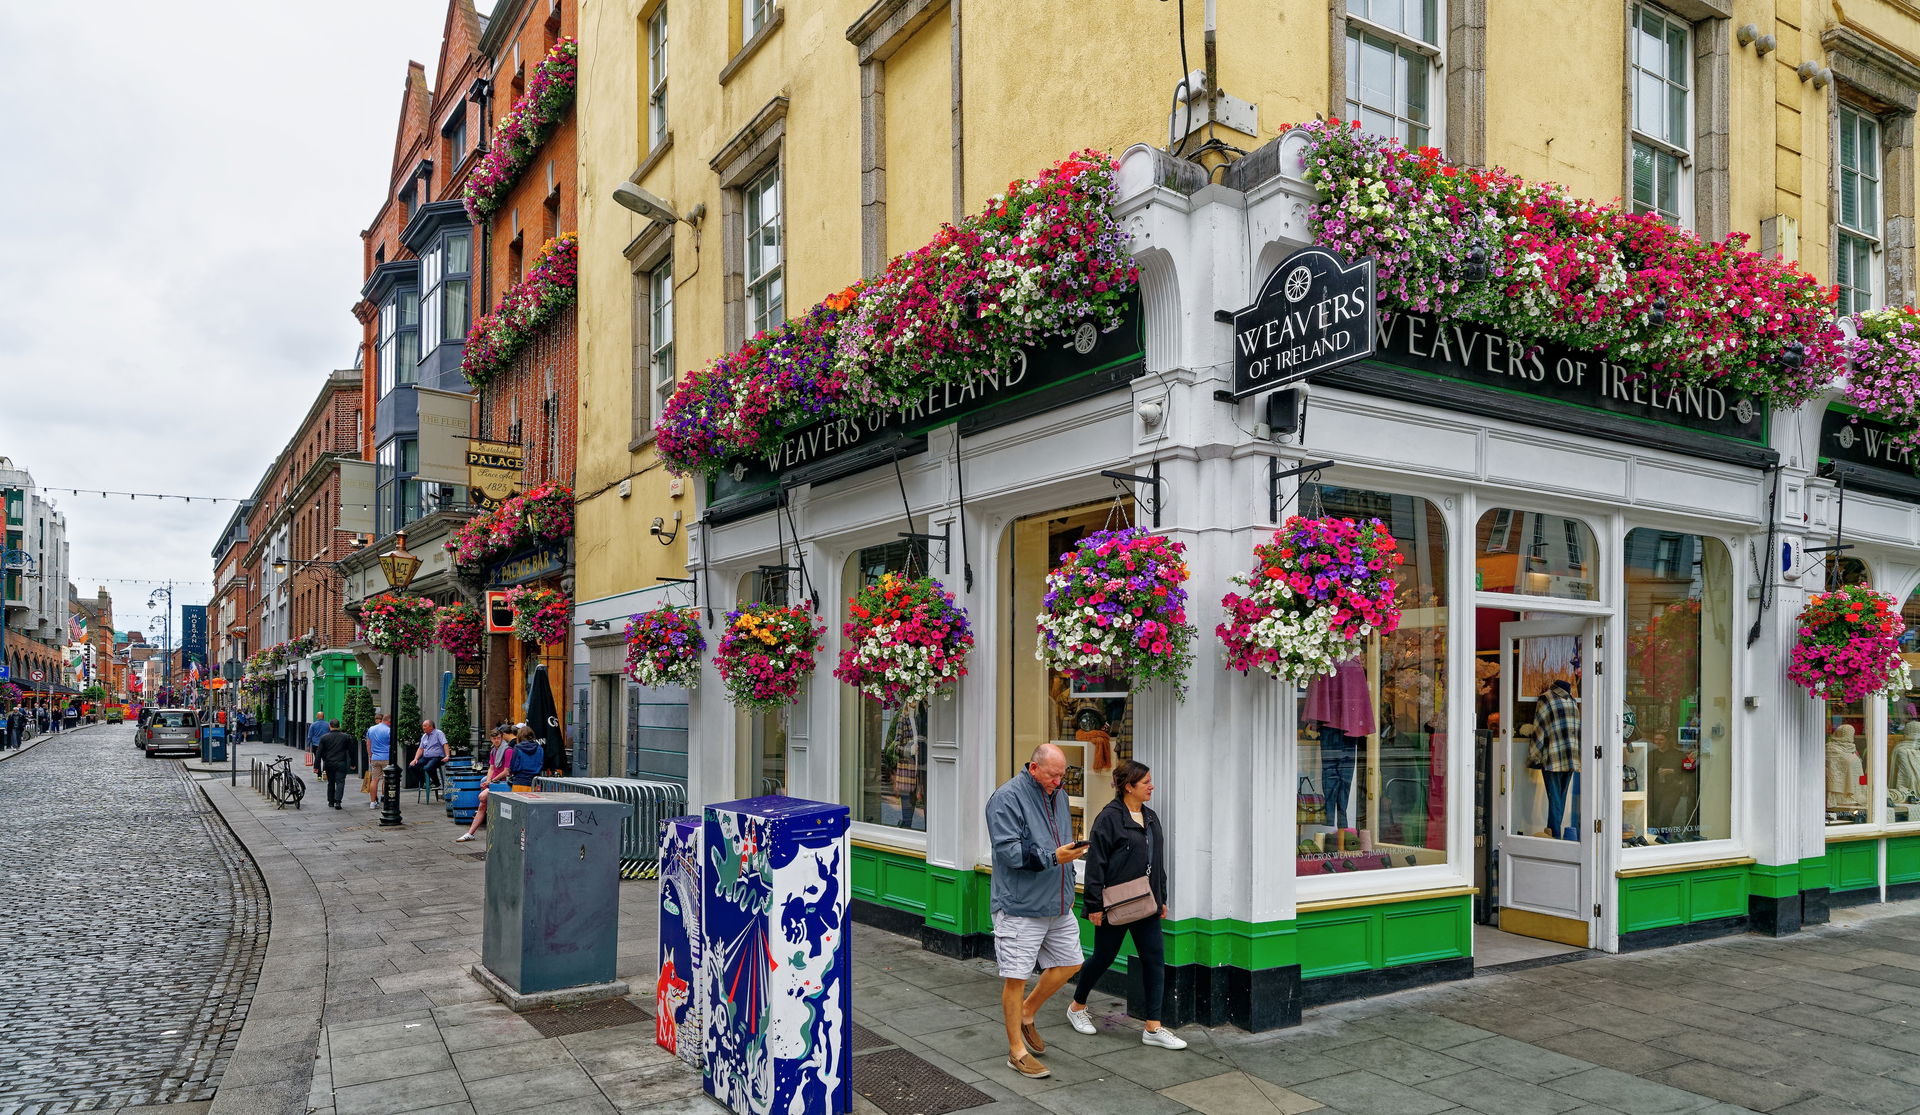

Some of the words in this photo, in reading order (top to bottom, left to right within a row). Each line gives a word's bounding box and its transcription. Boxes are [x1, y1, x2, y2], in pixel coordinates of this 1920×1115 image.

[1237, 286, 1366, 357] WEAVERS
[1249, 357, 1272, 380] OF
[1276, 330, 1351, 371] IRELAND
[1556, 357, 1588, 387] OF
[1600, 360, 1727, 422] IRELAND
[440, 417, 468, 429] FLEET
[469, 453, 524, 468] PALACE
[767, 416, 860, 473] WEAVERS
[481, 498, 501, 509] BA
[501, 557, 531, 582] PALACE
[532, 550, 550, 574] BAR
[1301, 852, 1332, 863] MUCROS
[1333, 848, 1364, 860] WEAVERS
